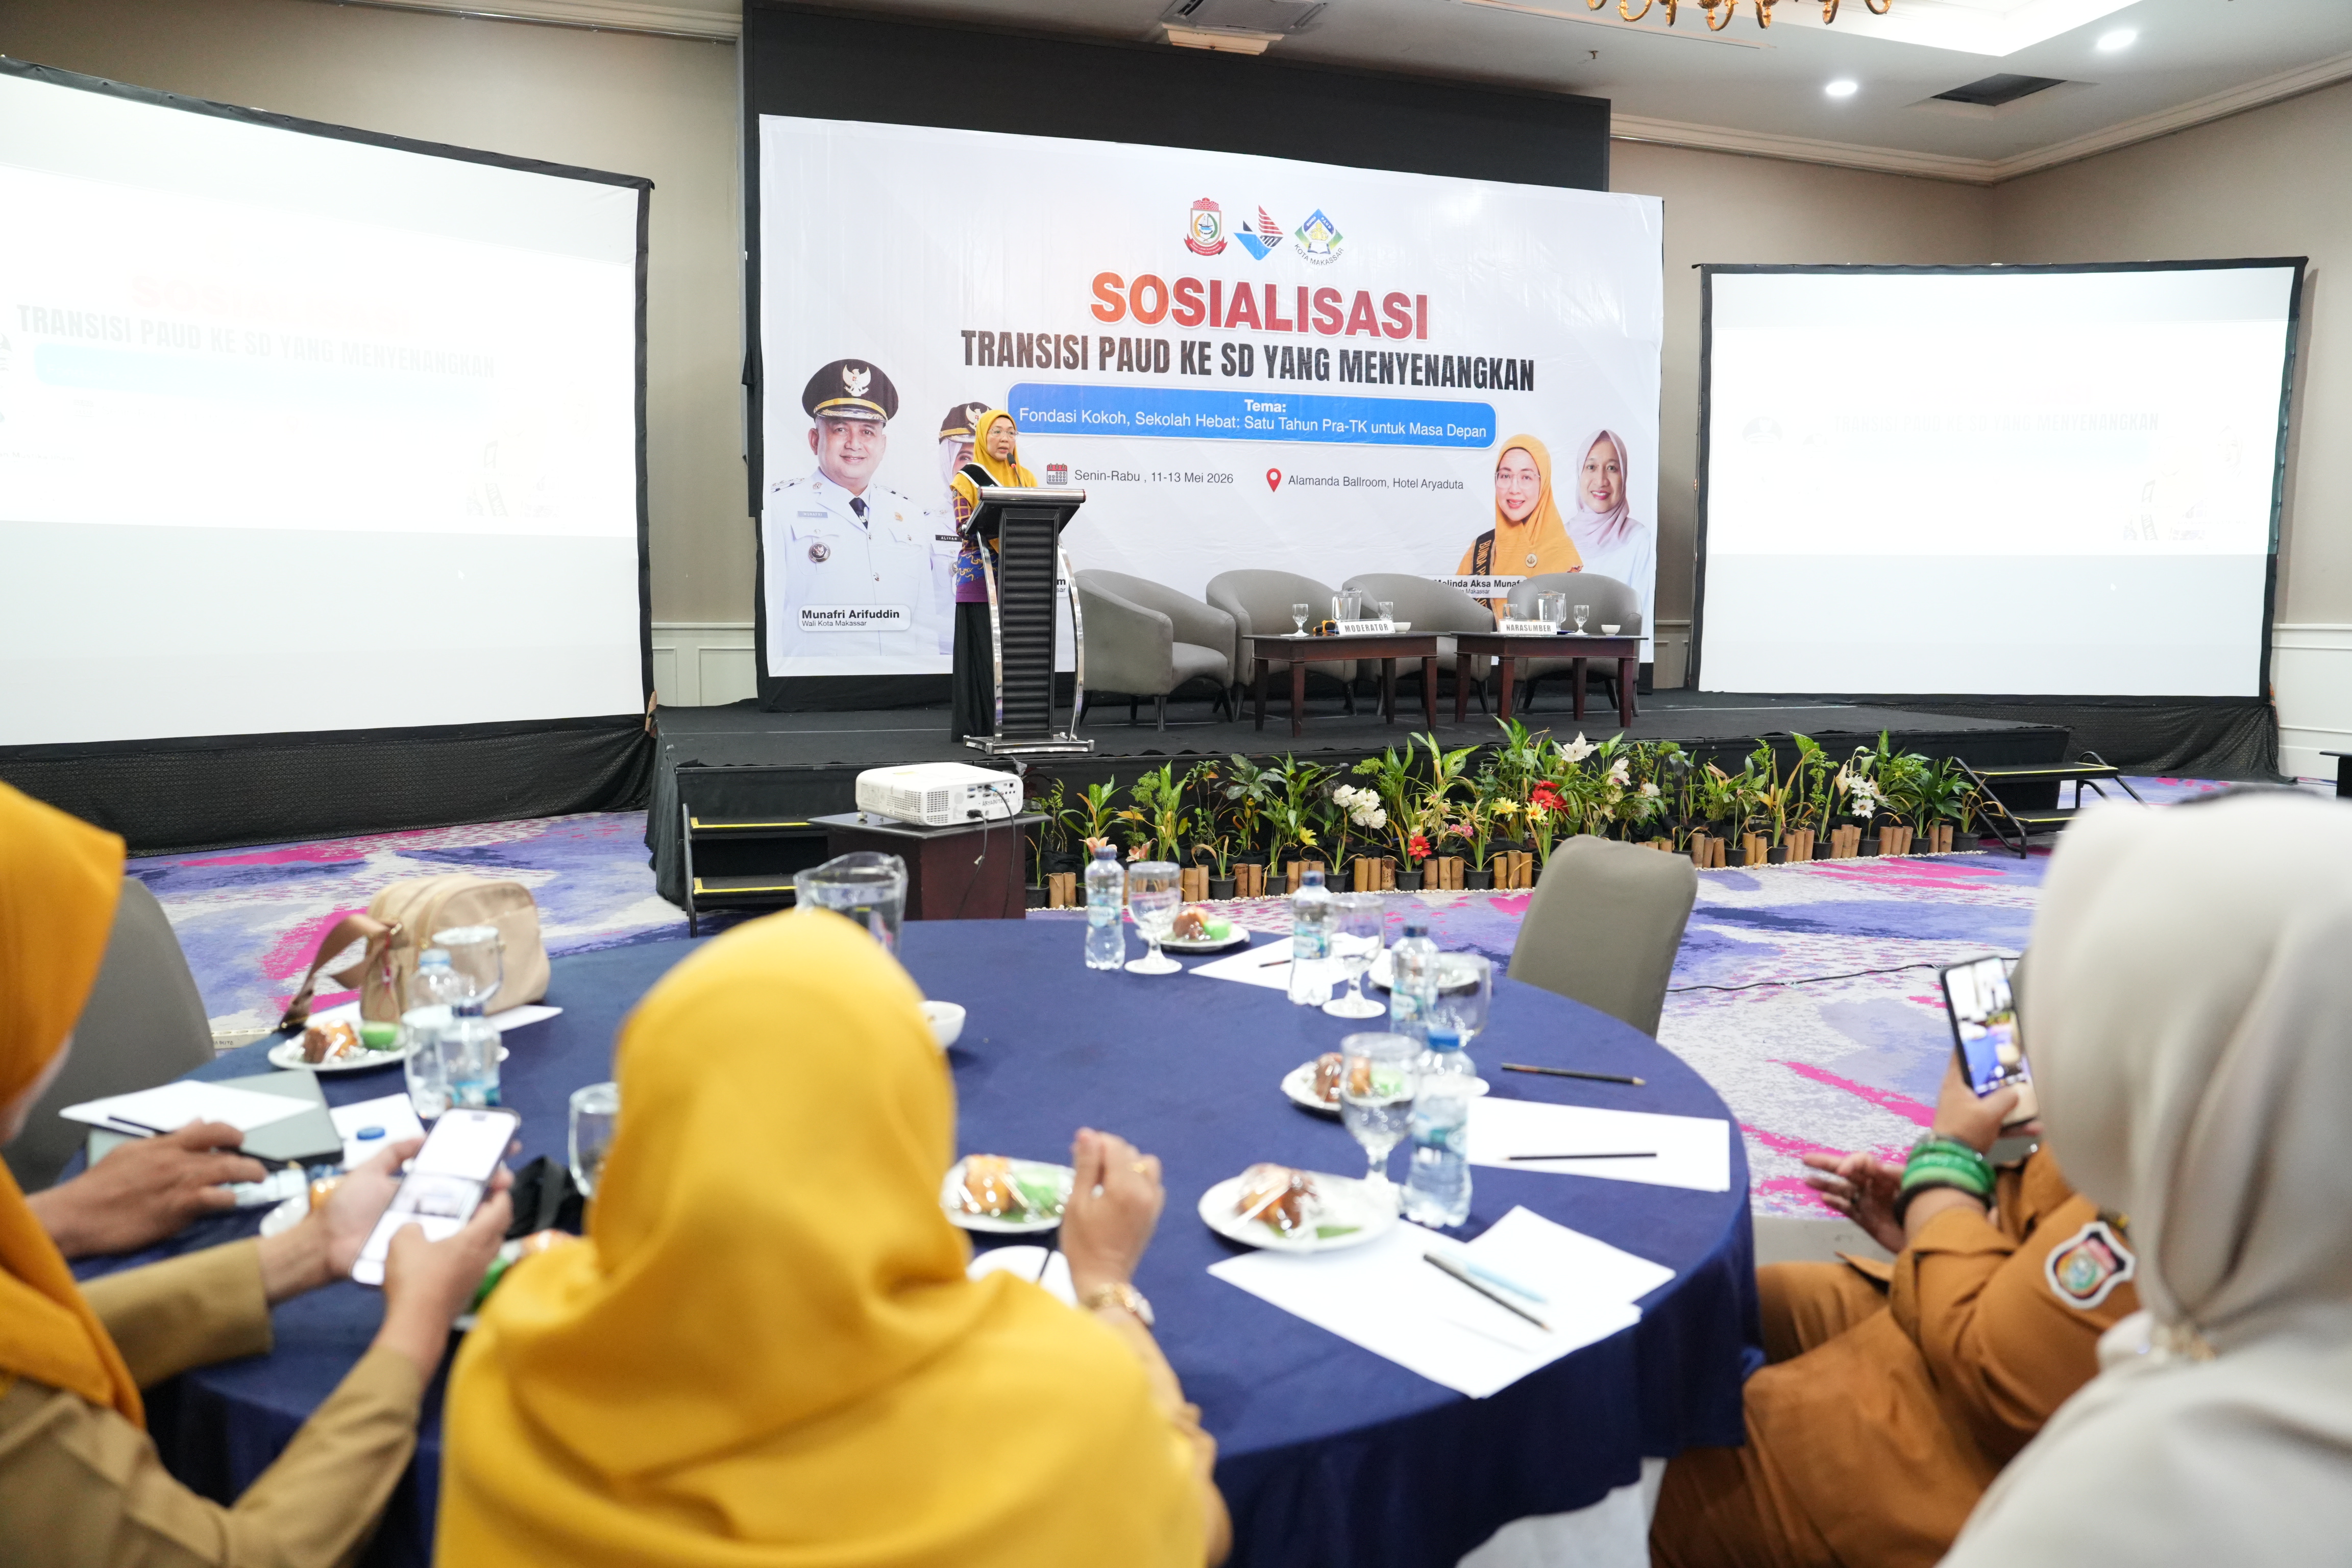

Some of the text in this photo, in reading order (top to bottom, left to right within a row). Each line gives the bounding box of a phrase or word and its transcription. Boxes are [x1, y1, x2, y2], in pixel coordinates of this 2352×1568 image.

[1306, 216, 1316, 227] BUNDA
[1321, 217, 1331, 229] PAUD
[1294, 244, 1344, 265] KOTA MAKASSAR
[1091, 272, 1427, 339] SOSIALISASI
[17, 304, 495, 379] TRANSISI PAUD KE SD YANG MENYENANGKAN
[961, 330, 1534, 391] TRANSISI PAUD KE SD YANG MENYENANGKAN
[1244, 399, 1286, 413] Tema:
[1019, 408, 1486, 439] Fondasi Kokoh, Sekolah Hebat: Satu Tahun Pra-TK untuk Masa Depan
[2038, 412, 2159, 432] MENYENANGKAN
[1074, 470, 1140, 481] Senin-Rabu
[1152, 472, 1181, 483] 11-13
[1185, 472, 1204, 483] Mei
[1207, 473, 1234, 483] 2026
[1288, 475, 1464, 491] Alamanda Ballroom, Hotel Aryaduta
[1476, 540, 1491, 568] BUNDA
[1471, 579, 1491, 587] Aksa
[802, 609, 899, 619] Munafri Arifuddin
[1344, 623, 1388, 632] MODERATOR
